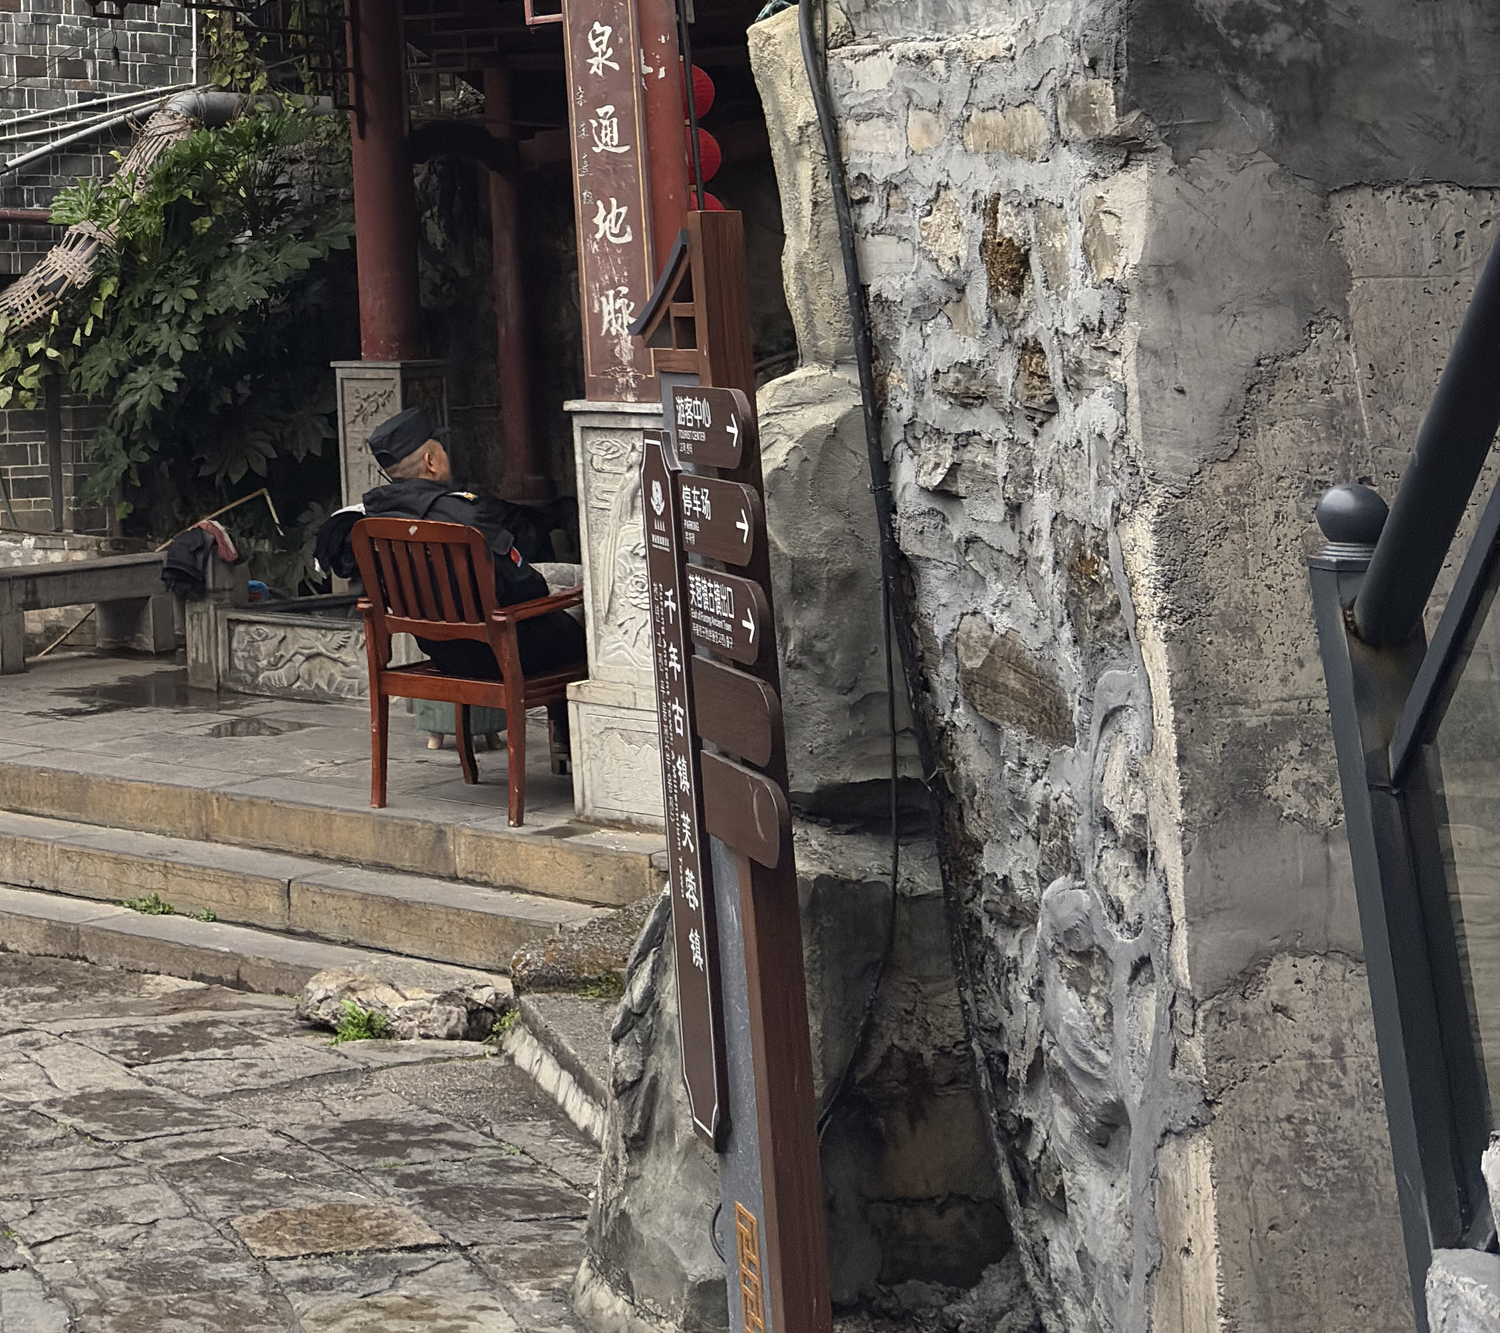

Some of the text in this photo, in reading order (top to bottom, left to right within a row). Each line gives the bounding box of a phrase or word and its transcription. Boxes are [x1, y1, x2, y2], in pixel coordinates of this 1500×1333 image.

[675, 395, 712, 429] 游客中心
[692, 431, 706, 442] CENTER
[682, 485, 712, 521] 停车场
